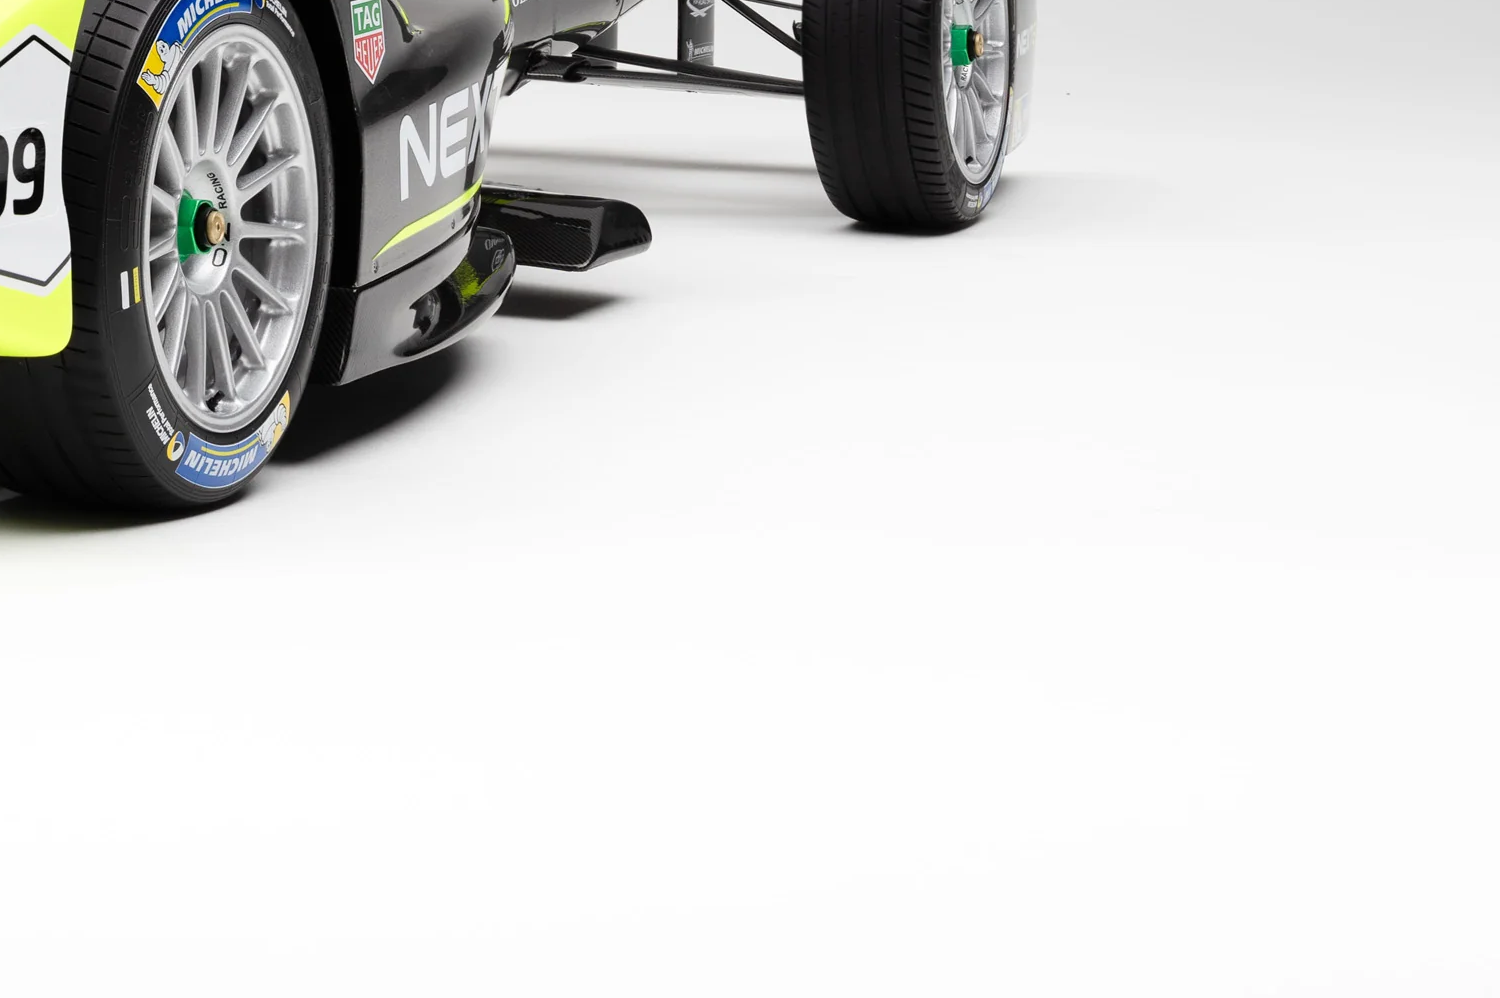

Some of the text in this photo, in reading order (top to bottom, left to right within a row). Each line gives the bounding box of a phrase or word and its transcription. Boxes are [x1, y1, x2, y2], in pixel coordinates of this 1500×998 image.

[354, 2, 382, 32] TAG
[355, 34, 384, 80] HEUER
[207, 172, 228, 209] RACING
[146, 406, 171, 445] MICHELIN
[184, 444, 259, 478] MICHELIN
